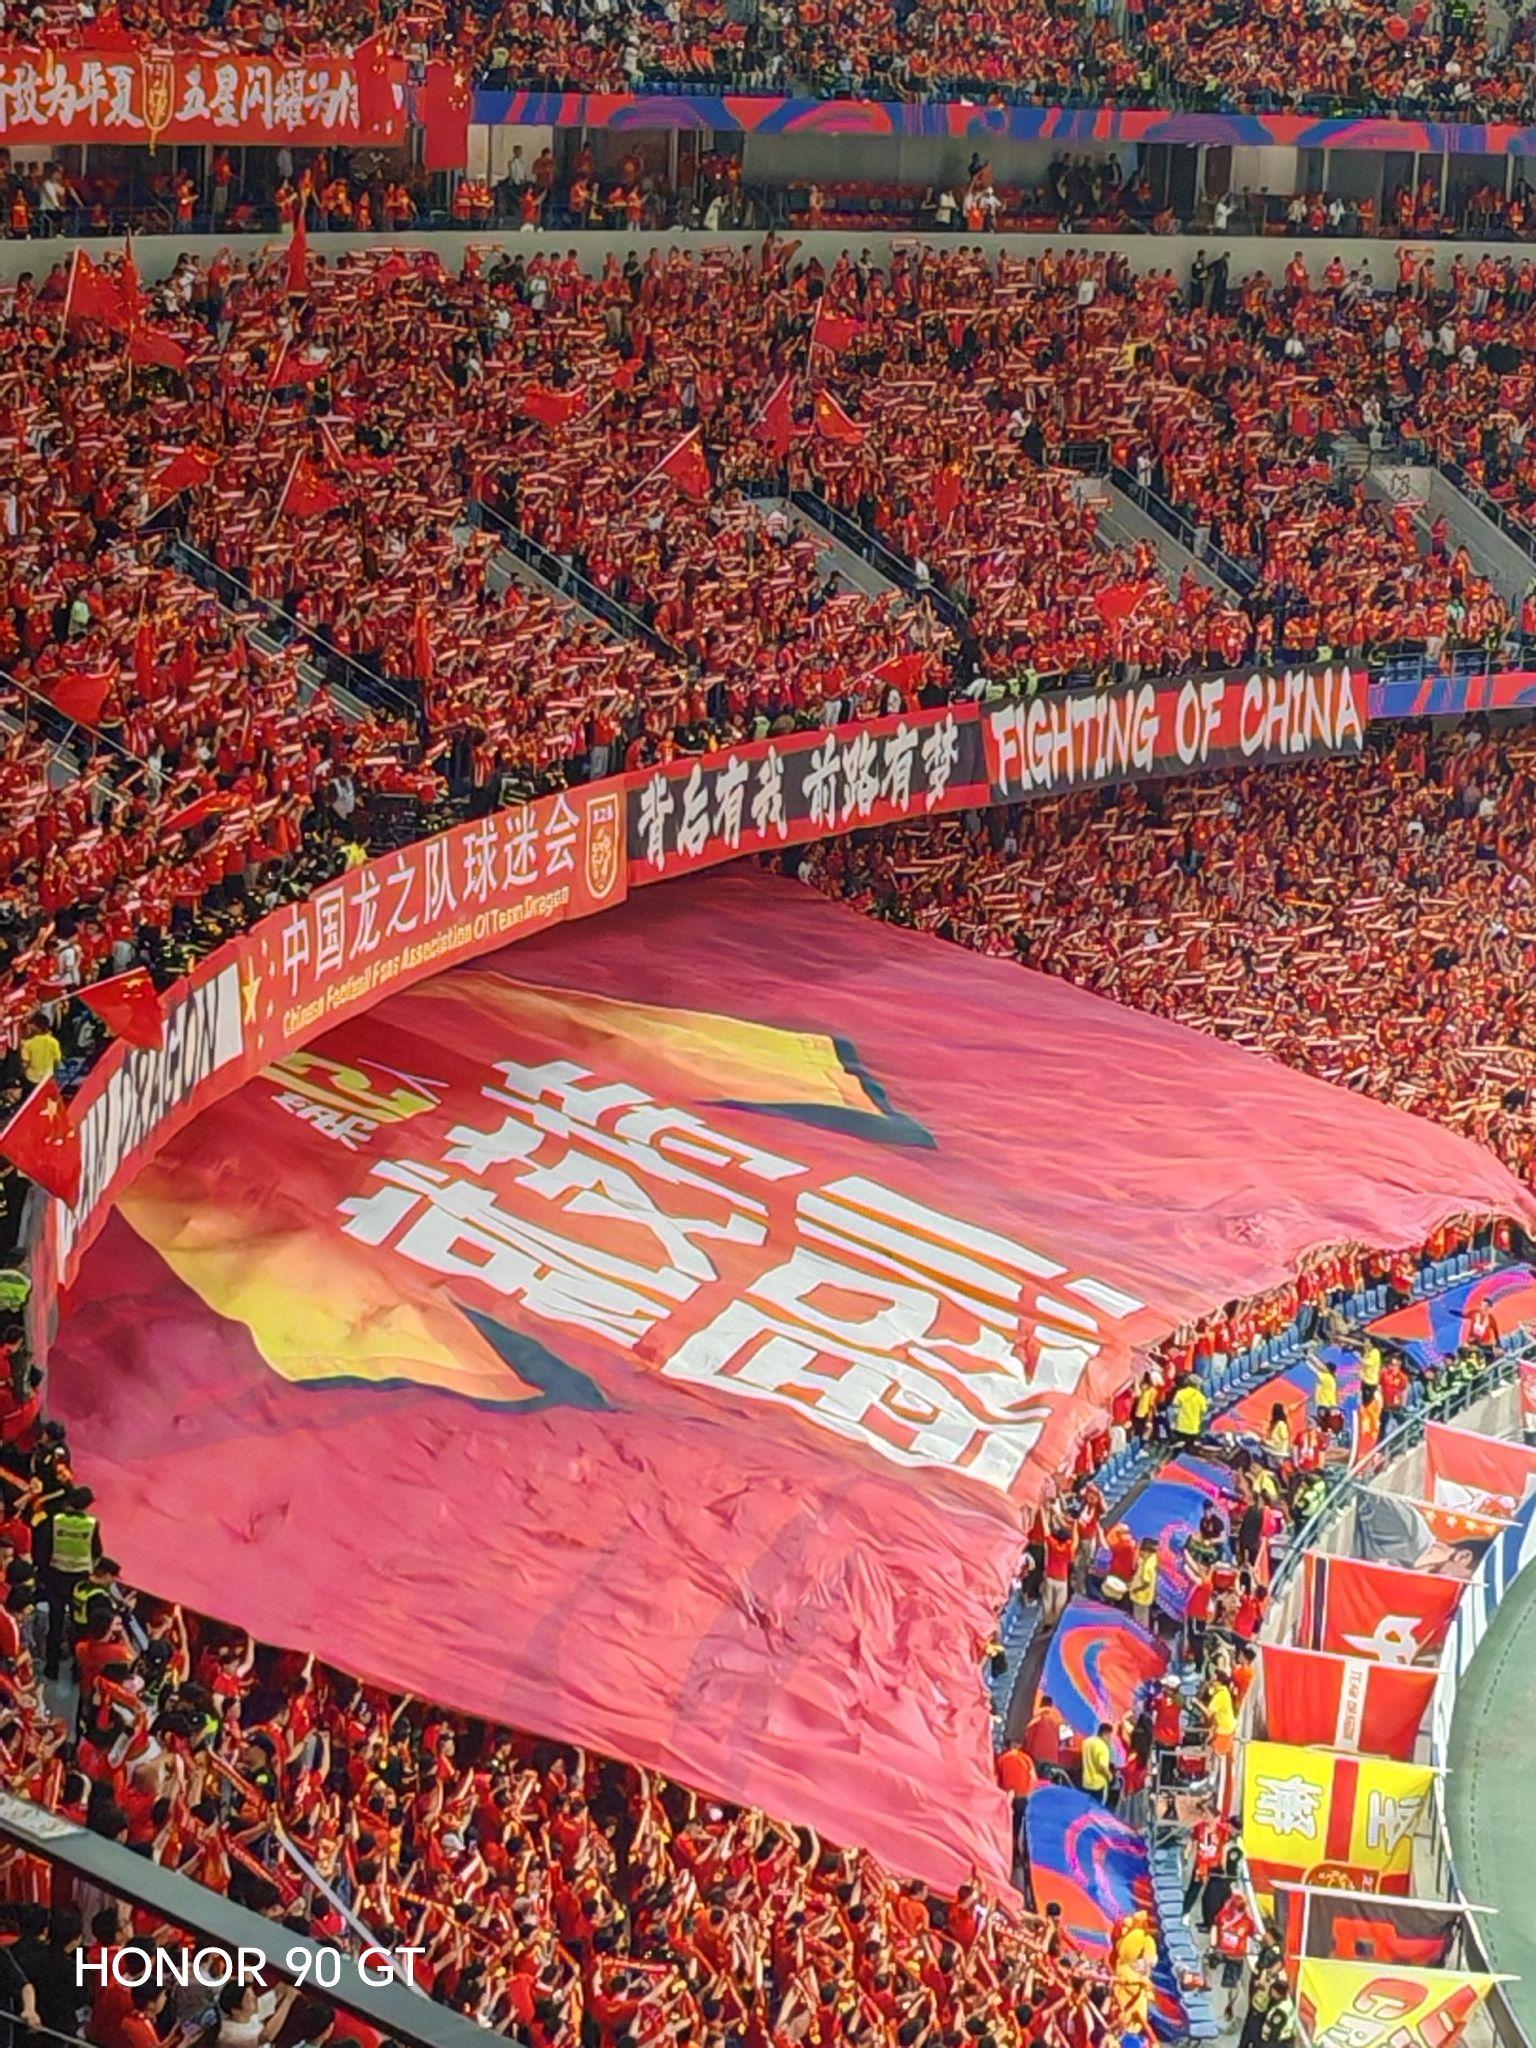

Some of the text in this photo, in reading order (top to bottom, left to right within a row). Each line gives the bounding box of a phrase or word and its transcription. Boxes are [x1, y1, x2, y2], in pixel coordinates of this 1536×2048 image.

[637, 712, 960, 872] 背后有我 前路有梦
[990, 666, 1364, 796] FIGHTING OF CHINA
[281, 792, 580, 997] 中国龙之队球迷会
[335, 1057, 810, 1348] 就支持
